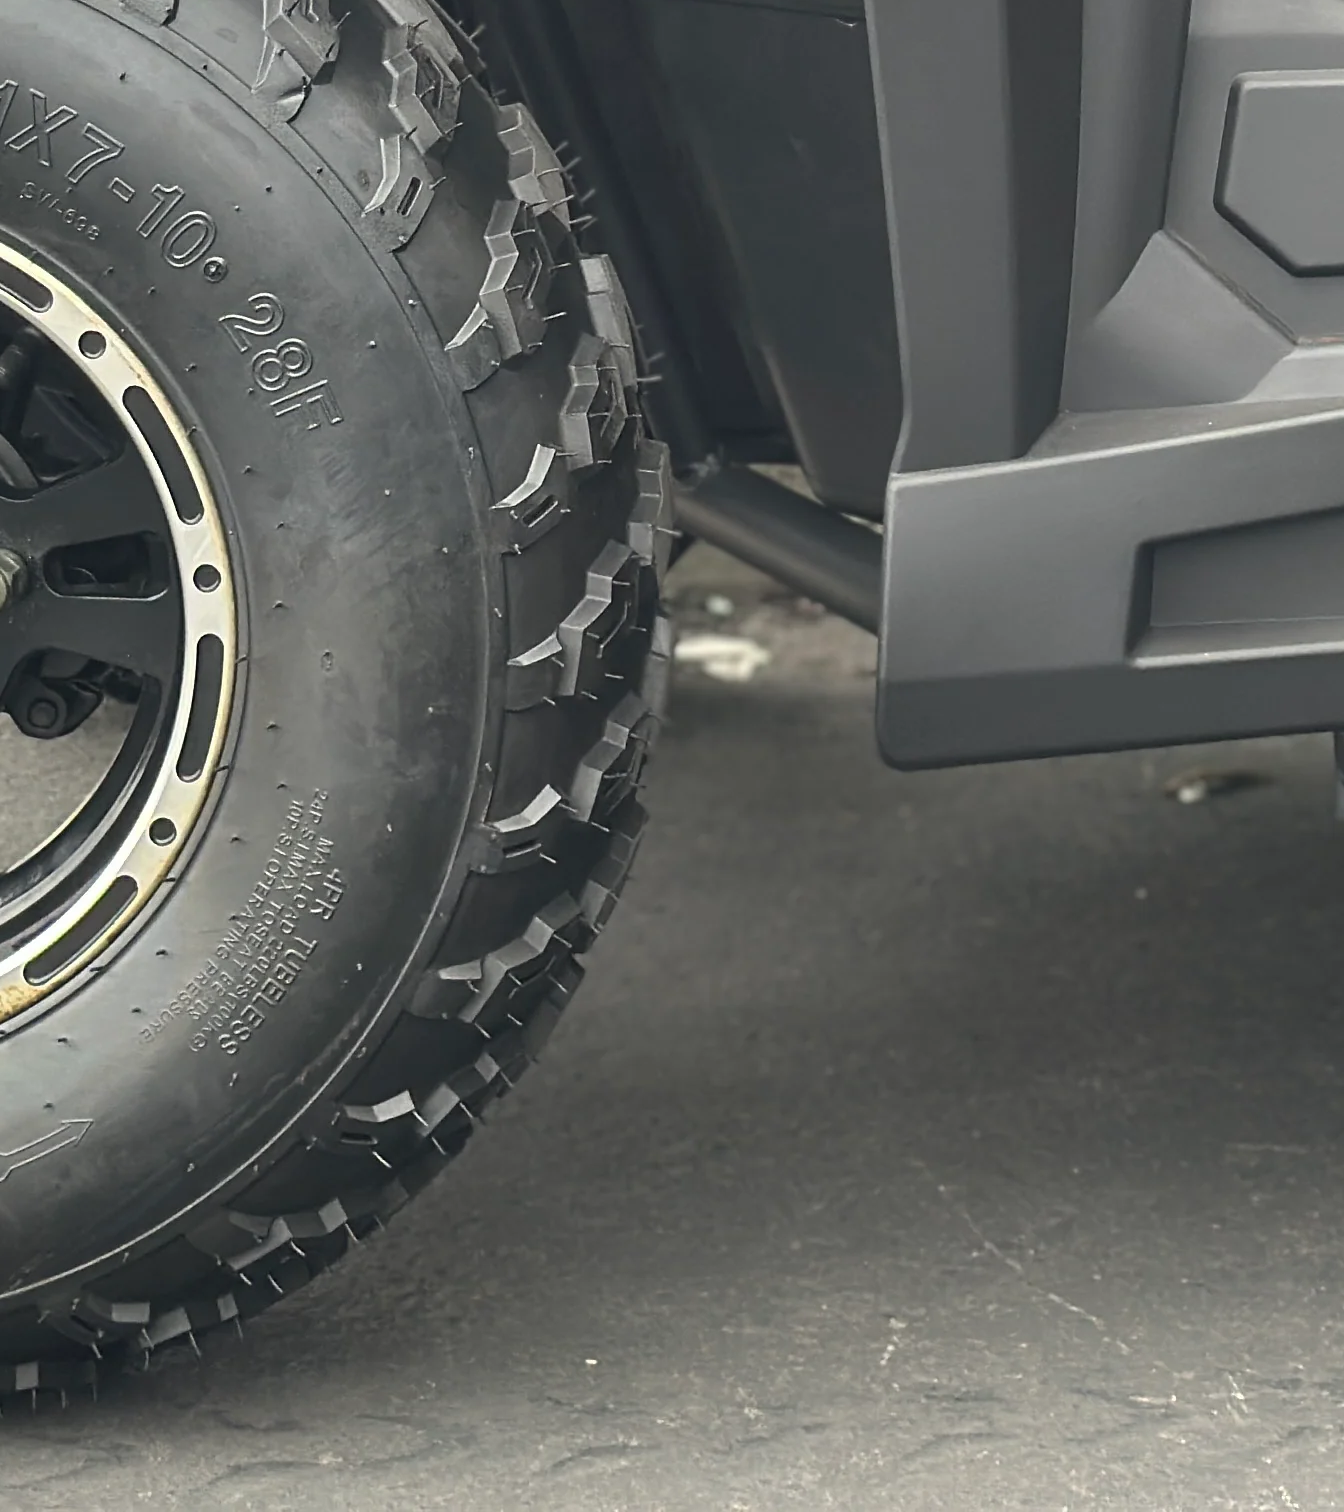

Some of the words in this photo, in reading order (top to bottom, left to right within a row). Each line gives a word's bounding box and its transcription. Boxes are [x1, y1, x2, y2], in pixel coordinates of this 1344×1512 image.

[217, 290, 345, 432] 28F
[309, 867, 346, 921] 4PR
[138, 961, 221, 1044] PRESSURE
[217, 937, 319, 1056] TUBELESS
